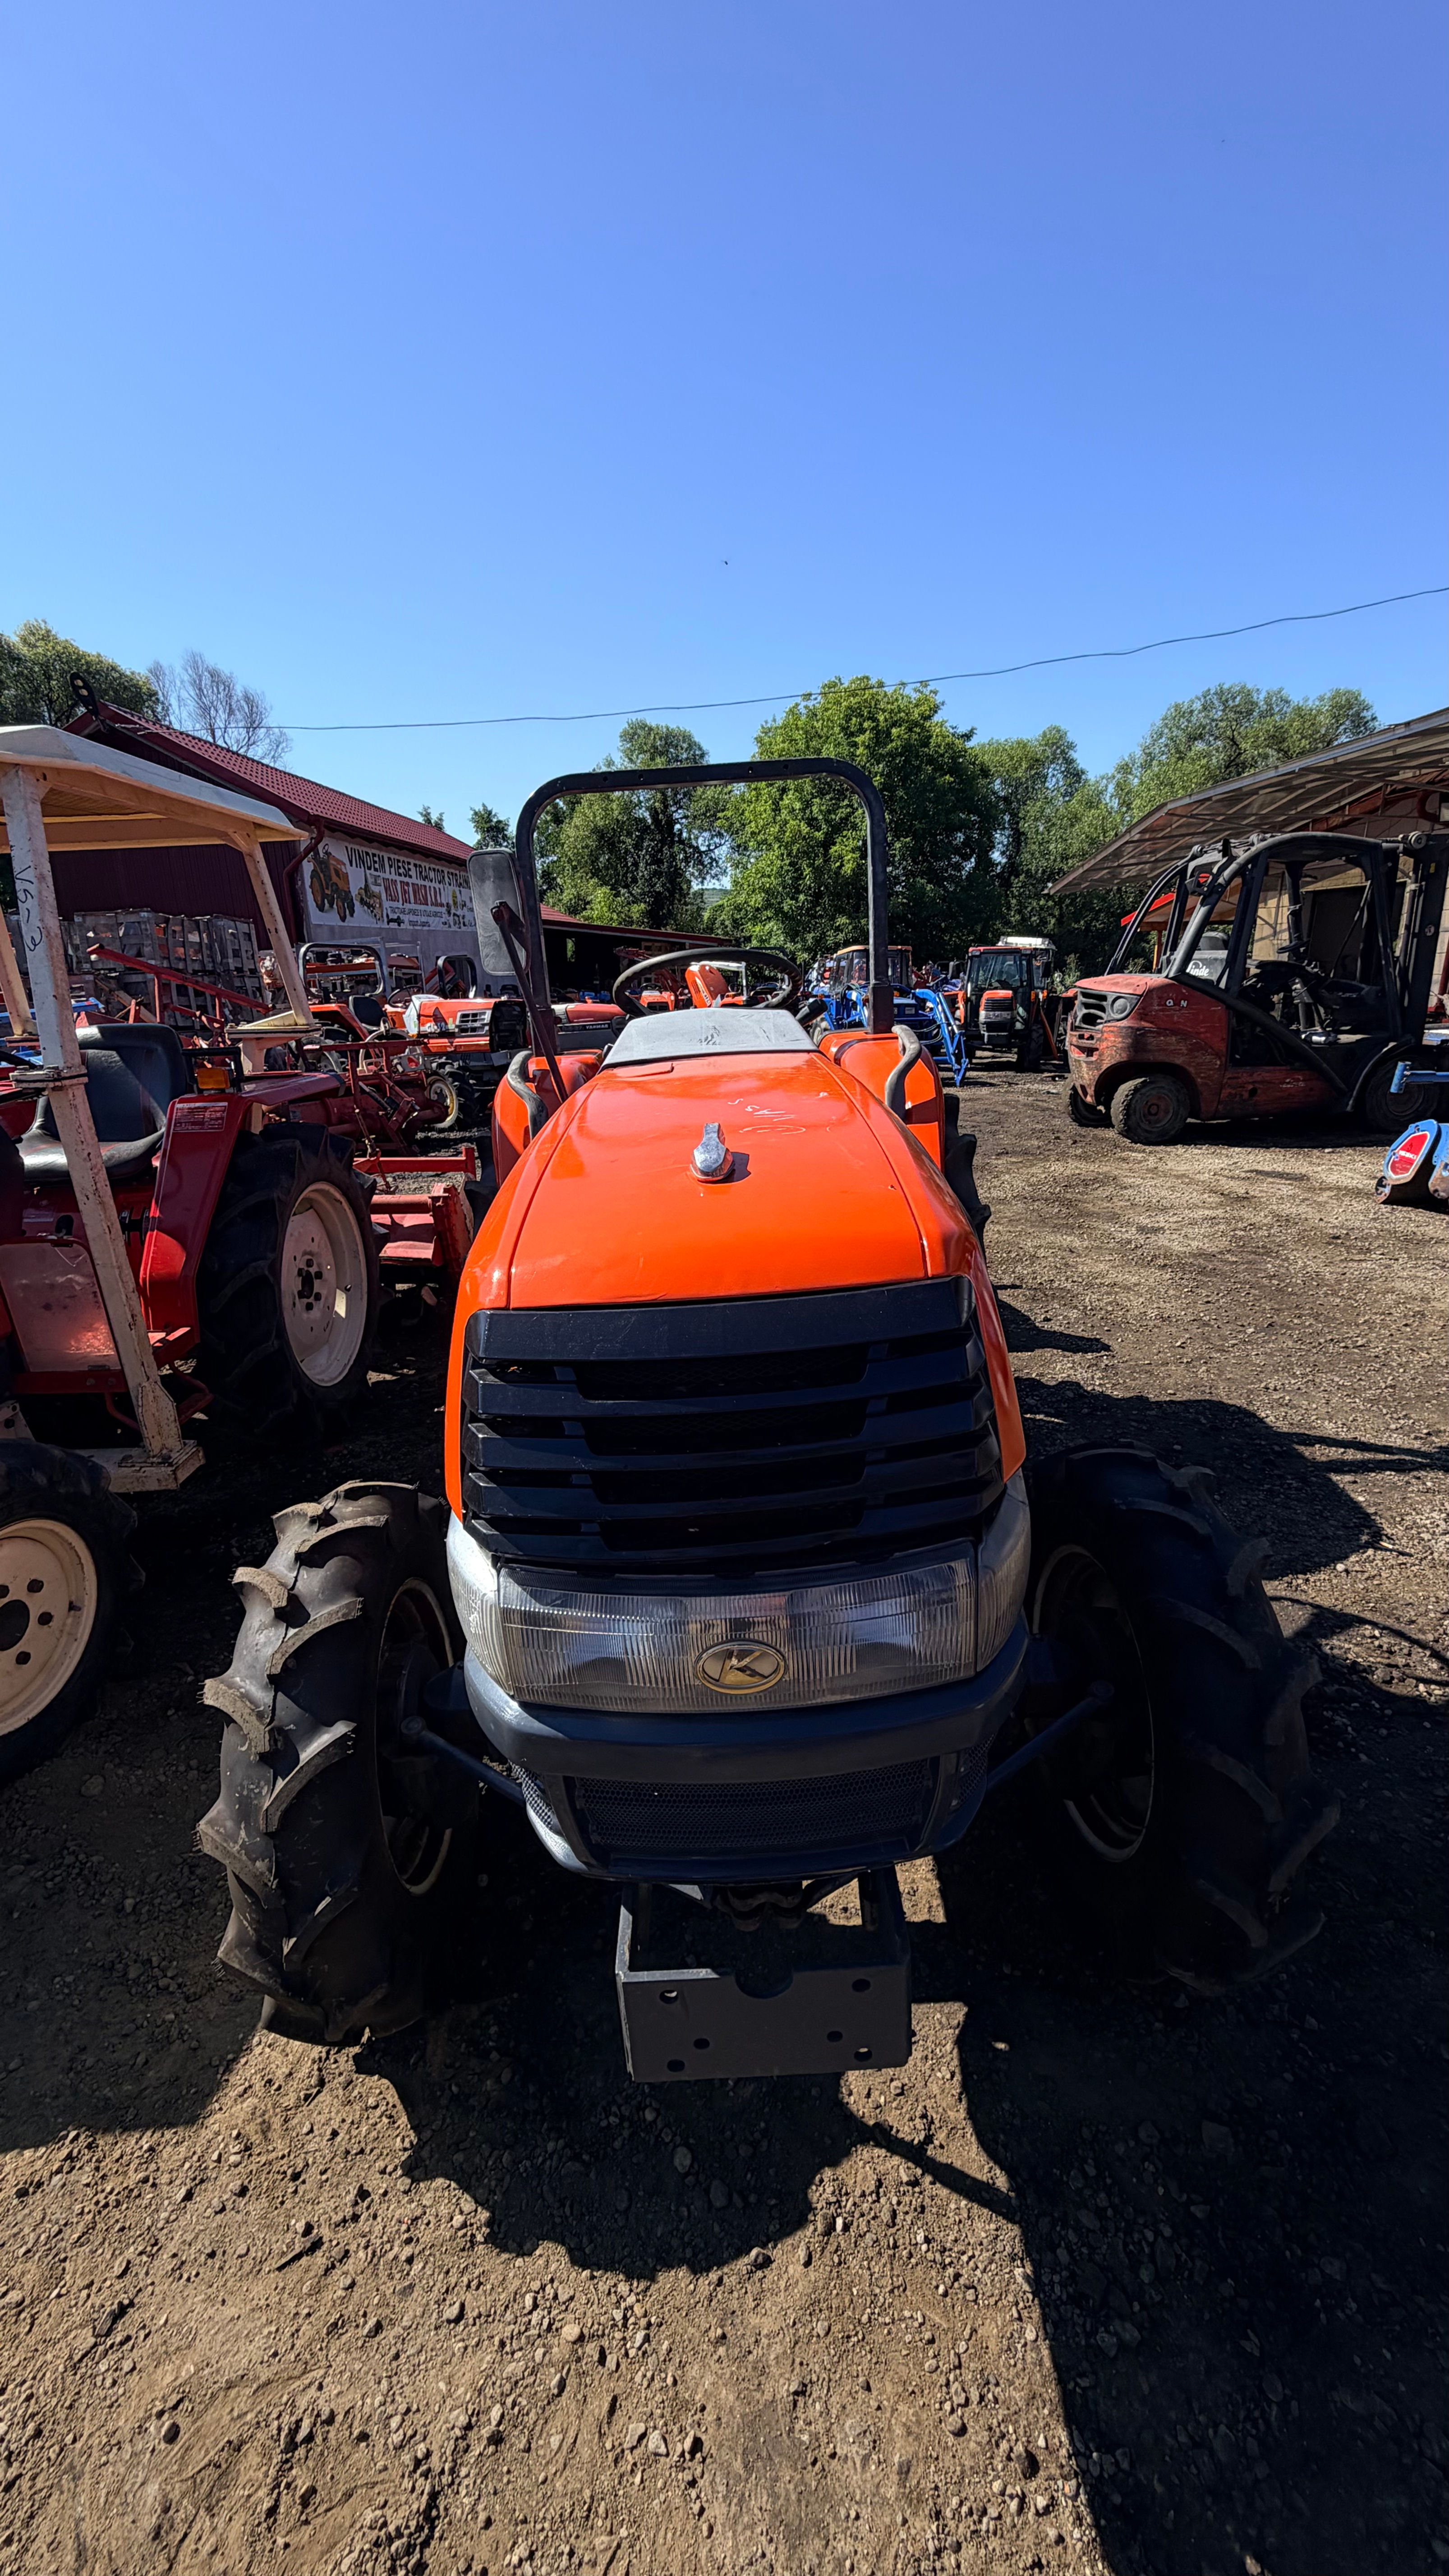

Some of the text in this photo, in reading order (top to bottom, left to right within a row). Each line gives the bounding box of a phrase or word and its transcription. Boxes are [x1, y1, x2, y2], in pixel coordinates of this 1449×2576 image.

[345, 846, 386, 874] VINDEM
[387, 856, 412, 879] PIESE
[413, 863, 446, 885] TRACTOR
[382, 877, 399, 902] VASS
[400, 880, 411, 906] JET
[411, 883, 429, 906] WASH
[1186, 960, 1209, 976] Linde
